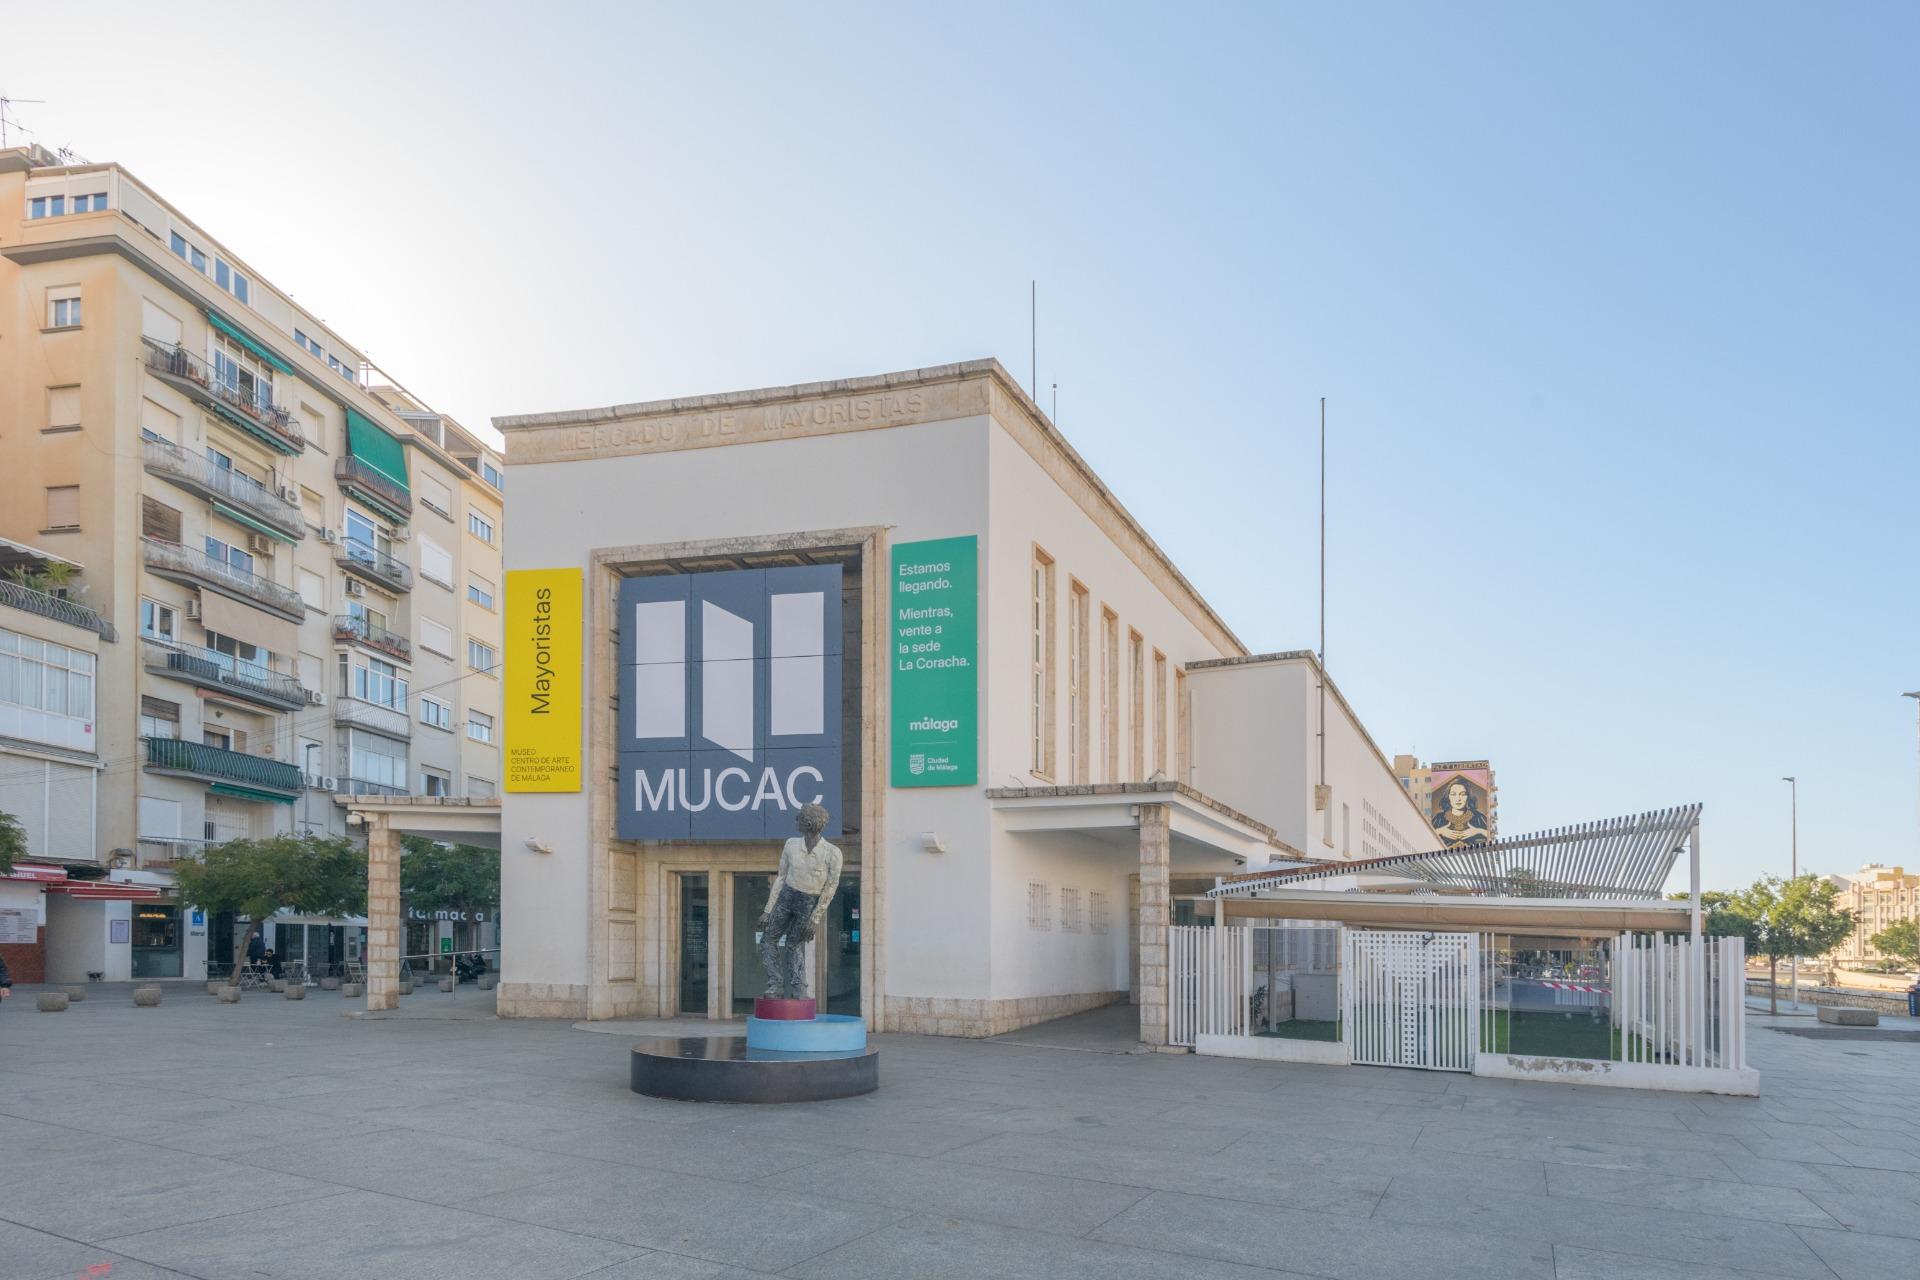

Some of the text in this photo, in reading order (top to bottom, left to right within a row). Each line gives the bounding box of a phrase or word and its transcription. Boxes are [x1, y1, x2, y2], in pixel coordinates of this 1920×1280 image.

[560, 393, 922, 450] MERCADO DE MAYORISTAS
[899, 562, 951, 576] Estamos
[899, 578, 953, 595] llegando.
[899, 606, 954, 621] Mientras,
[899, 624, 942, 637] vente a
[531, 588, 555, 714] Mayoristas
[899, 640, 941, 654] la sede
[899, 656, 970, 671] La Coracha.
[551, 756, 570, 764] ARTE
[927, 756, 949, 764] Ciudad
[927, 763, 936, 771] de
[511, 774, 520, 782] DE
[635, 765, 824, 812] MUCAC
[408, 907, 484, 921] famaca
